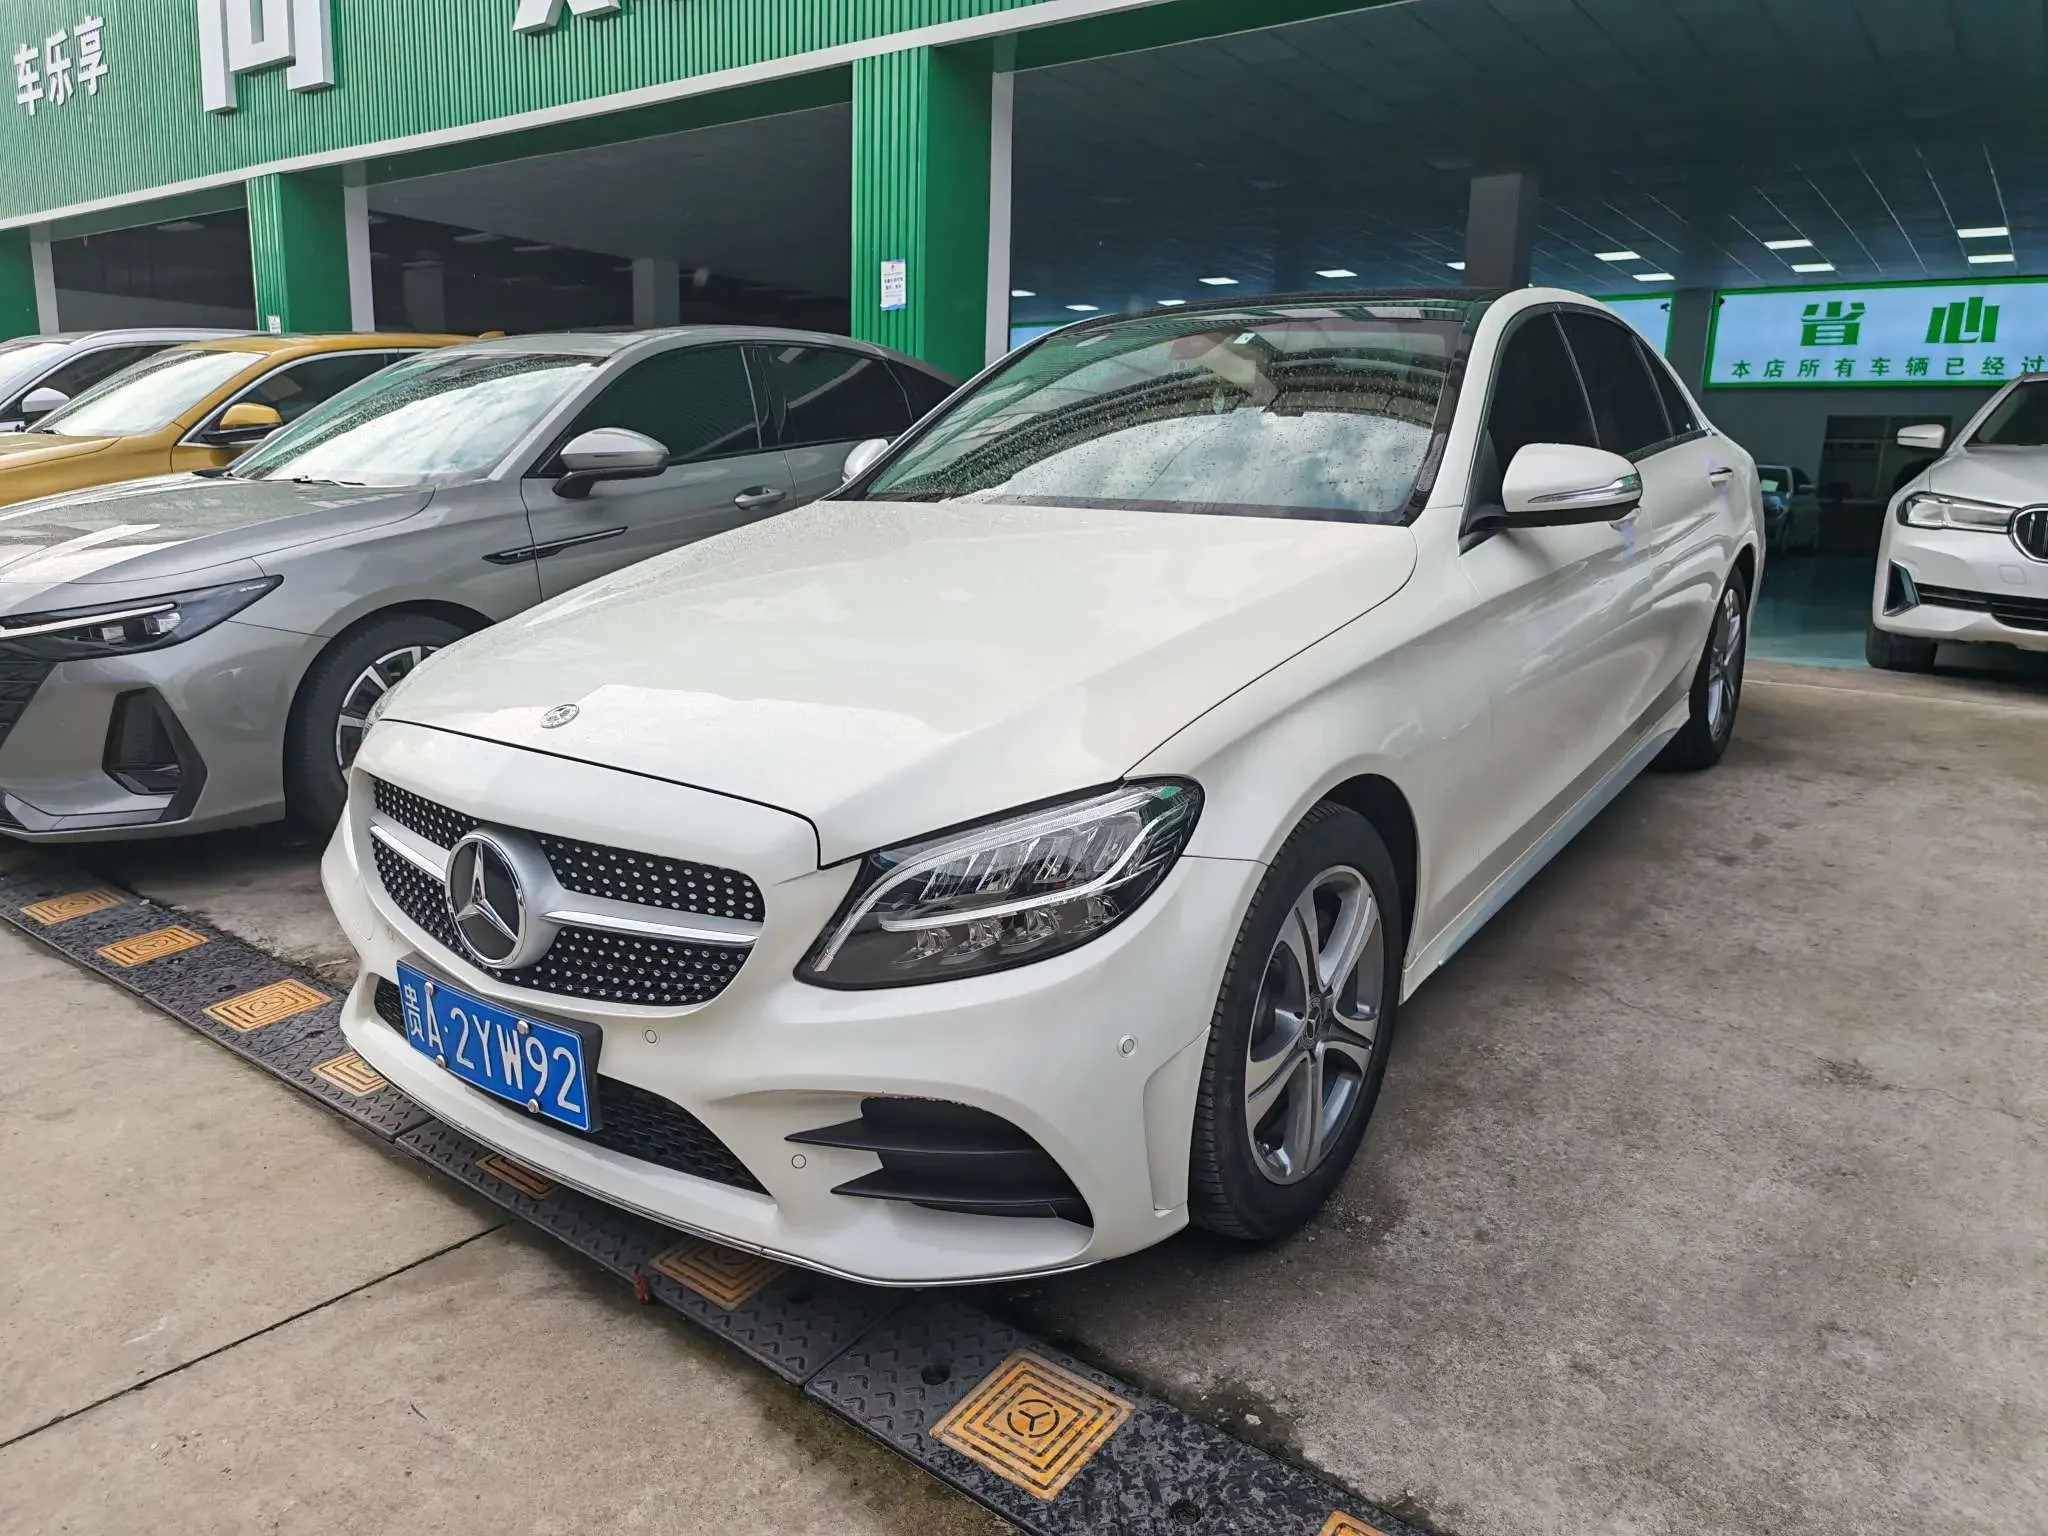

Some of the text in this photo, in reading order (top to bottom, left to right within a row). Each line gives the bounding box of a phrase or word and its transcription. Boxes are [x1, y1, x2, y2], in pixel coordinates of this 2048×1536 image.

[13, 15, 109, 117] 车乐享
[1800, 297, 2000, 346] 省心
[1731, 355, 2045, 379] 本店所有车辆已经过
